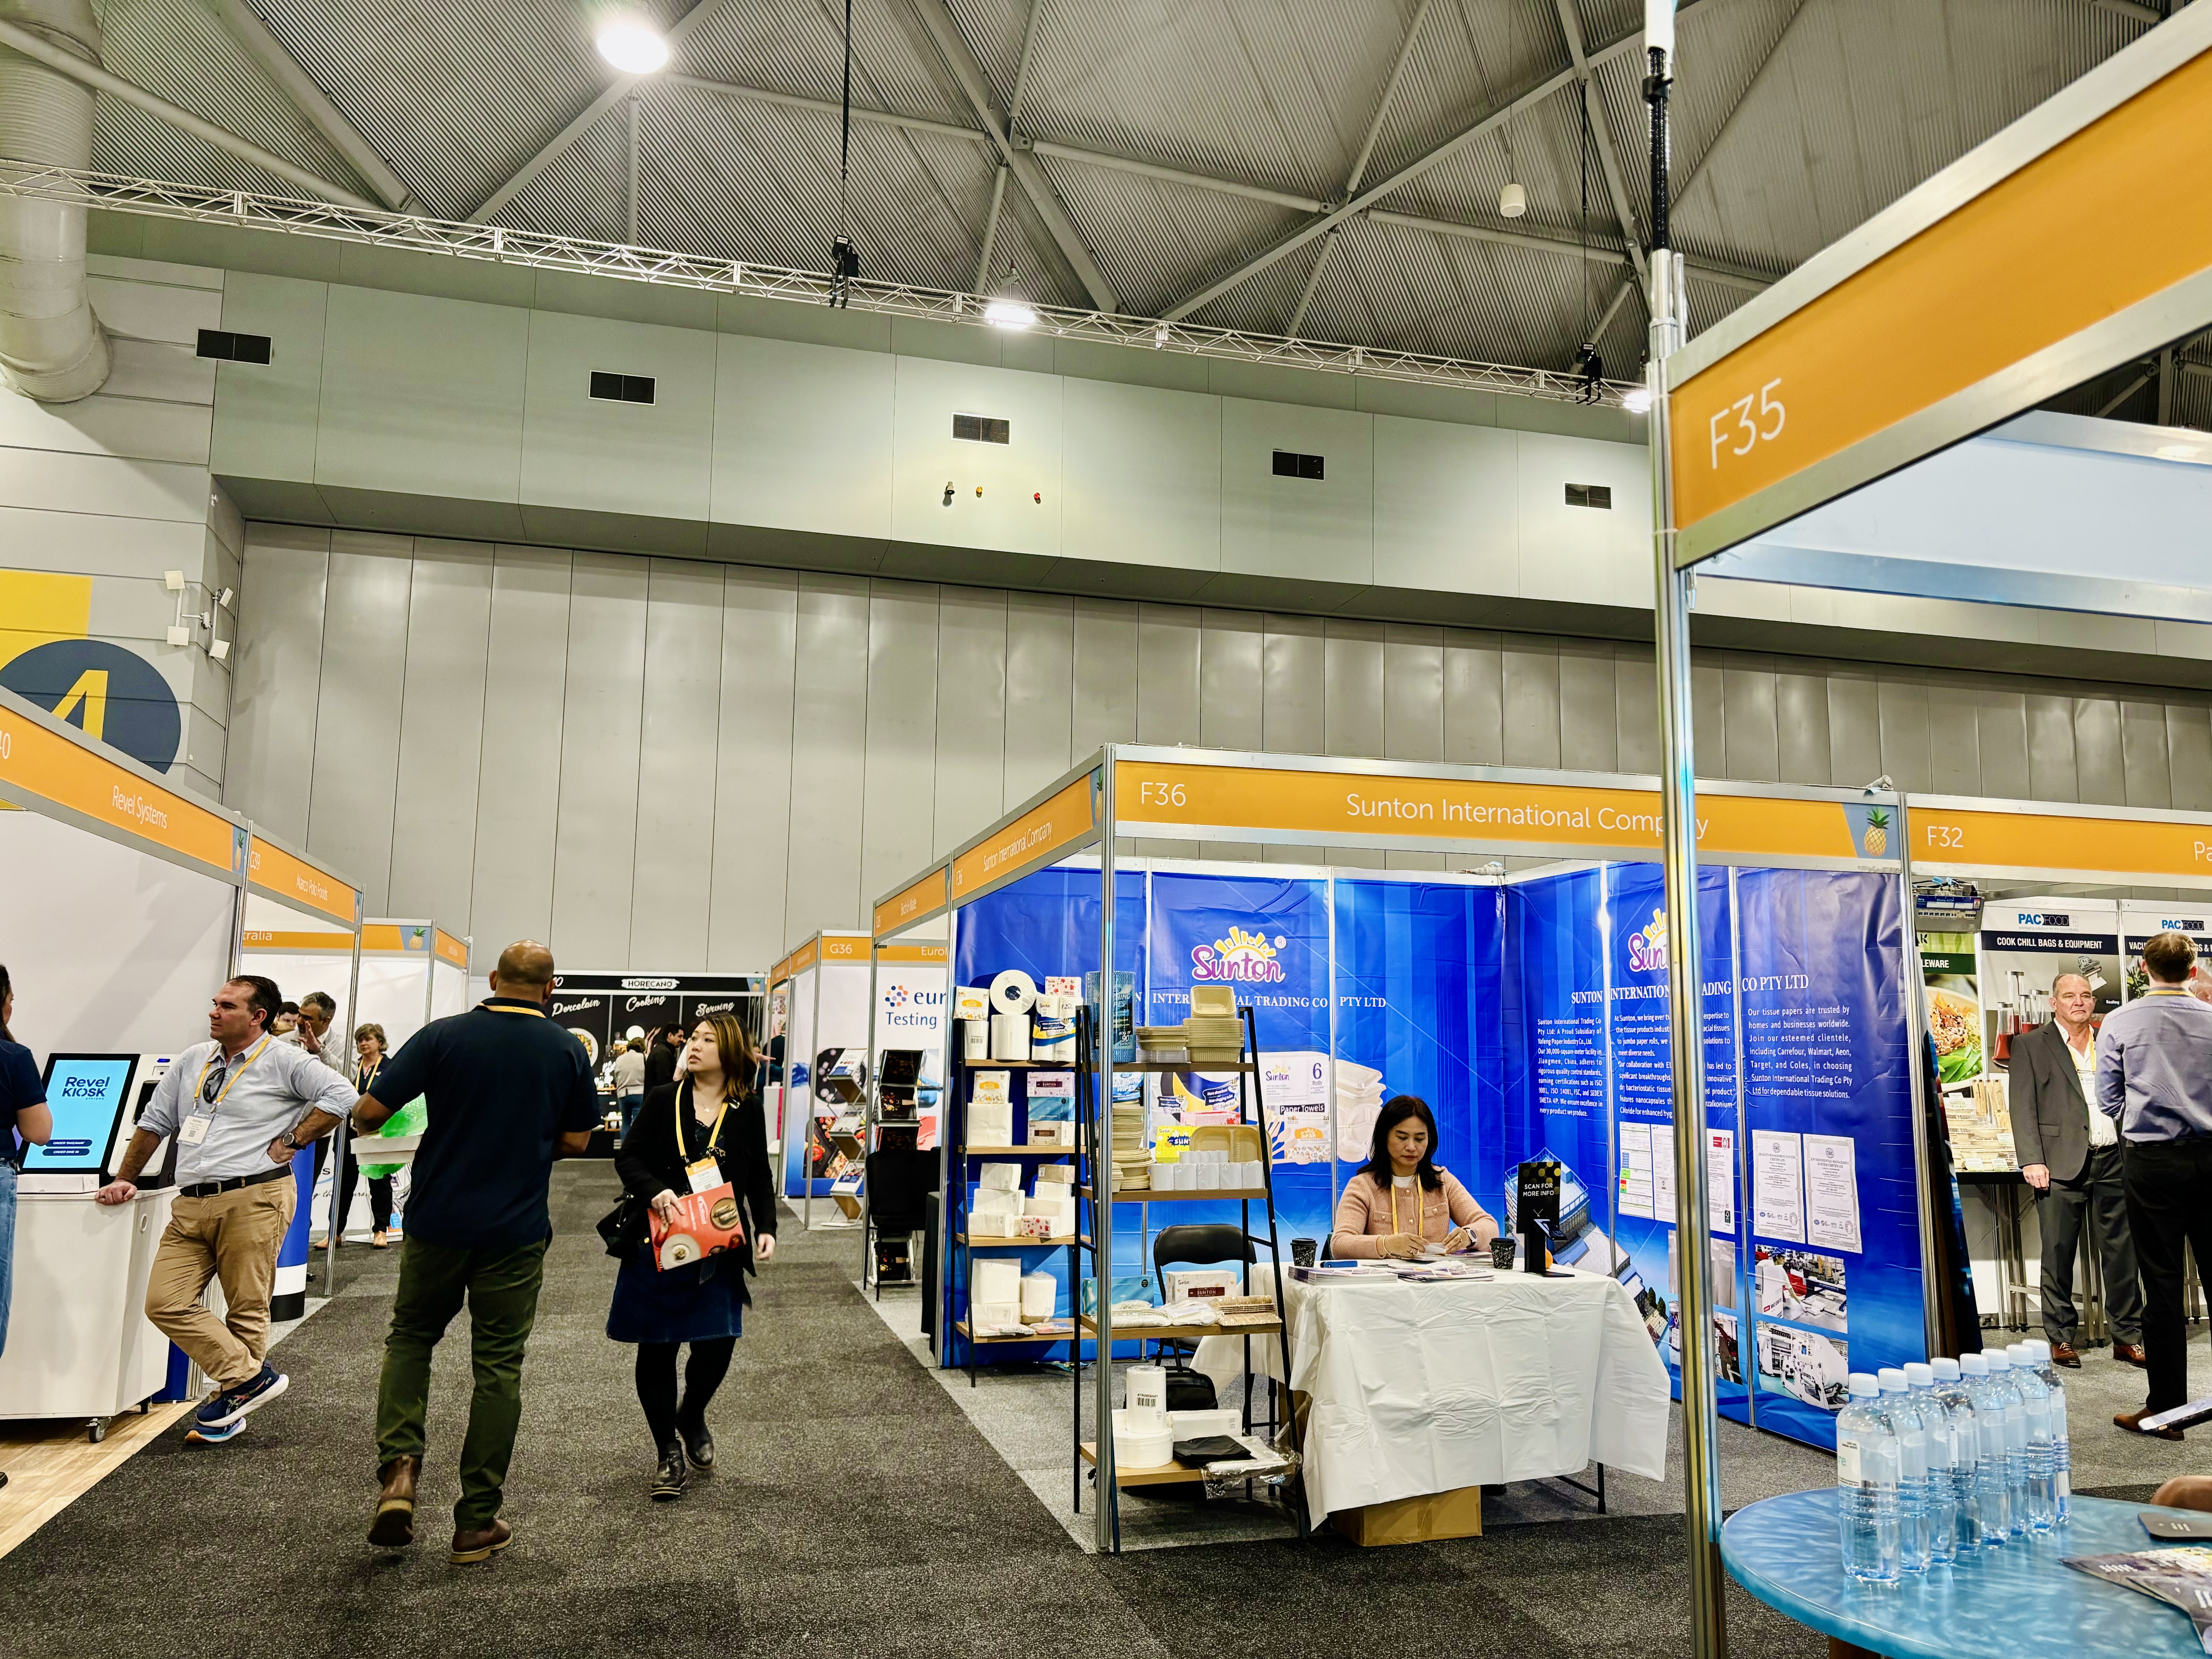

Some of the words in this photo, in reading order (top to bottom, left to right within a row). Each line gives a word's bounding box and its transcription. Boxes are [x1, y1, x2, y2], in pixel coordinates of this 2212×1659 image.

[1711, 378, 1785, 470] F35
[1140, 782, 1187, 807] F36
[112, 785, 135, 815] Revel
[136, 797, 167, 829] Systems
[1347, 793, 1433, 819] Sunton
[1443, 799, 1591, 828] International
[1598, 807, 1709, 839] Compy
[1927, 826, 1964, 848] F32
[984, 853, 998, 872] Sunton
[999, 831, 1026, 864] International
[1027, 821, 1052, 847] Company
[250, 851, 260, 870] G39
[297, 873, 308, 893] Marco
[309, 879, 317, 896] Polo
[317, 883, 328, 901] Foods
[830, 944, 852, 954] G36
[1997, 937, 2016, 946] COOK
[2017, 938, 2037, 946] CHILL
[2038, 939, 2056, 947] BAGS
[2065, 940, 2102, 949] EQUIPMENT
[1628, 933, 1668, 972] Sun
[1191, 945, 1286, 983] Sunton
[1571, 990, 1603, 1005] SUNTON
[1701, 981, 1731, 996] ADING
[1742, 977, 1757, 991] CO
[1759, 975, 1782, 991] PTY
[1784, 974, 1809, 989] LTD
[552, 997, 601, 1017] Porcelain
[626, 995, 666, 1012] Cooking
[1152, 993, 1252, 1006] INTERAL
[1254, 996, 1309, 1007] TRADING
[1312, 998, 1328, 1008] CO
[1340, 996, 1362, 1007] PTY
[1364, 996, 1386, 1007] LTD
[696, 1001, 735, 1017] Serving
[1782, 1008, 1803, 1017] papers
[1818, 1005, 1839, 1014] trusted
[1843, 1005, 1850, 1015] by
[886, 1012, 937, 1029] Testing
[1818, 1019, 1850, 1027] worldwide.
[1637, 1026, 1654, 1034] products
[1781, 1034, 1814, 1042] esteemed
[1818, 1033, 1851, 1043] clientele,
[1750, 1048, 1776, 1057] including
[1778, 1048, 1806, 1057] Carrefour,
[1808, 1048, 1834, 1057] Walmart,
[1836, 1048, 1851, 1057] Aeon,
[1313, 1063, 1322, 1079] 6
[1751, 1061, 1773, 1070] Target,
[1790, 1061, 1811, 1070] Coles,
[1823, 1061, 1852, 1072] choosing
[65, 1077, 110, 1087] Revel
[1266, 1071, 1289, 1081] Sunton
[1752, 1073, 1771, 1082] Sunton
[1772, 1075, 1809, 1083] International
[1811, 1075, 1833, 1085] Trading
[1843, 1076, 1852, 1086] Pty
[62, 1088, 107, 1097] KIOSK
[1712, 1087, 1733, 1096] product
[1770, 1087, 1803, 1097] dependable
[1804, 1089, 1823, 1097] tissue
[1823, 1090, 1850, 1099] solutions.
[1642, 1108, 1662, 1116] enhanced
